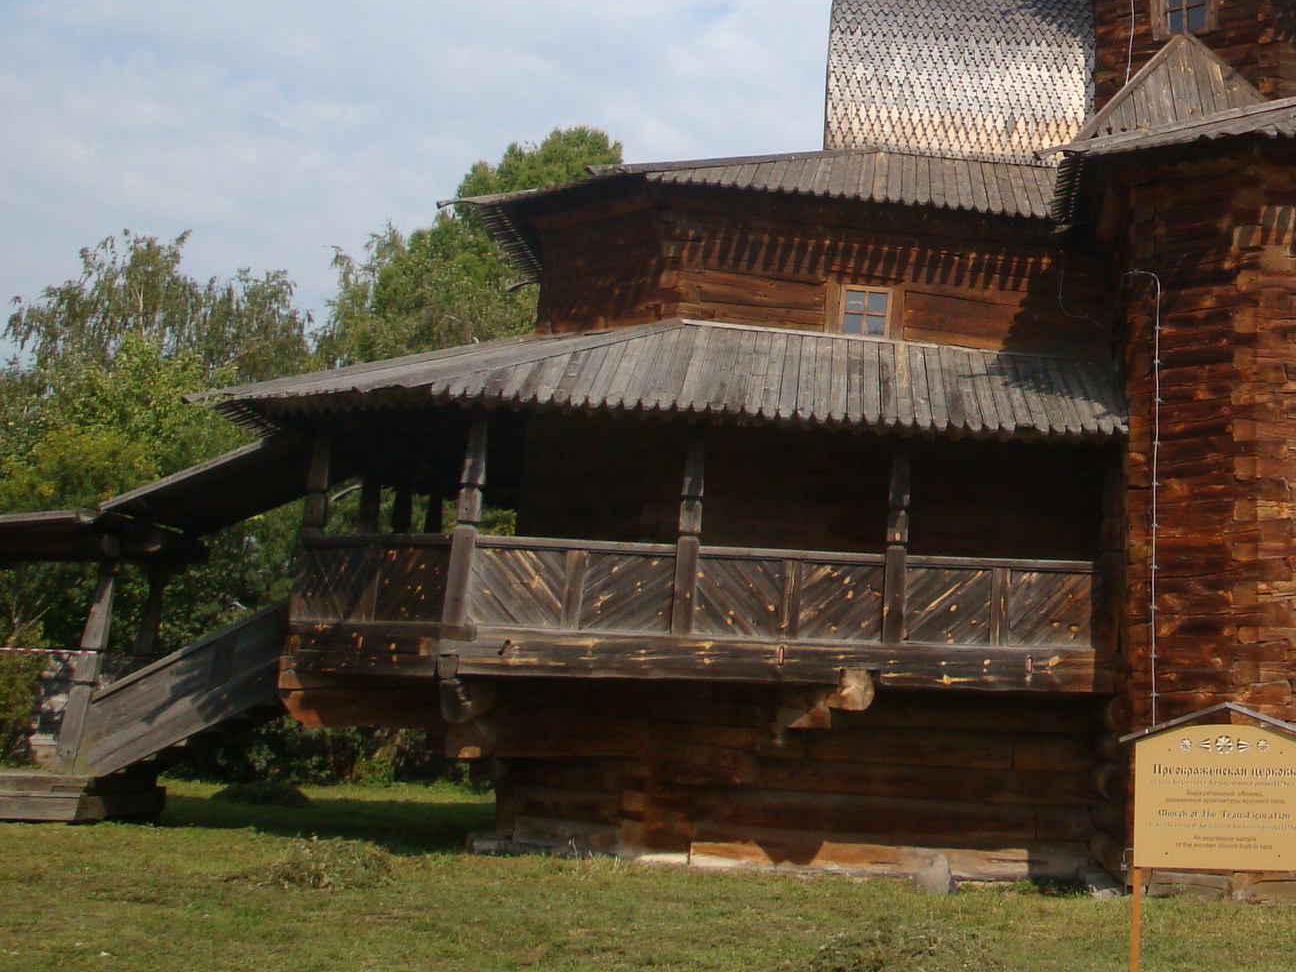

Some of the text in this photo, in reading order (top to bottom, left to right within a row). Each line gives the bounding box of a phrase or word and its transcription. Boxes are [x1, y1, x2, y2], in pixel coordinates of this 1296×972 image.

[1252, 766, 1296, 778] церковь
[1158, 808, 1291, 820] Church of the Transfiguration
